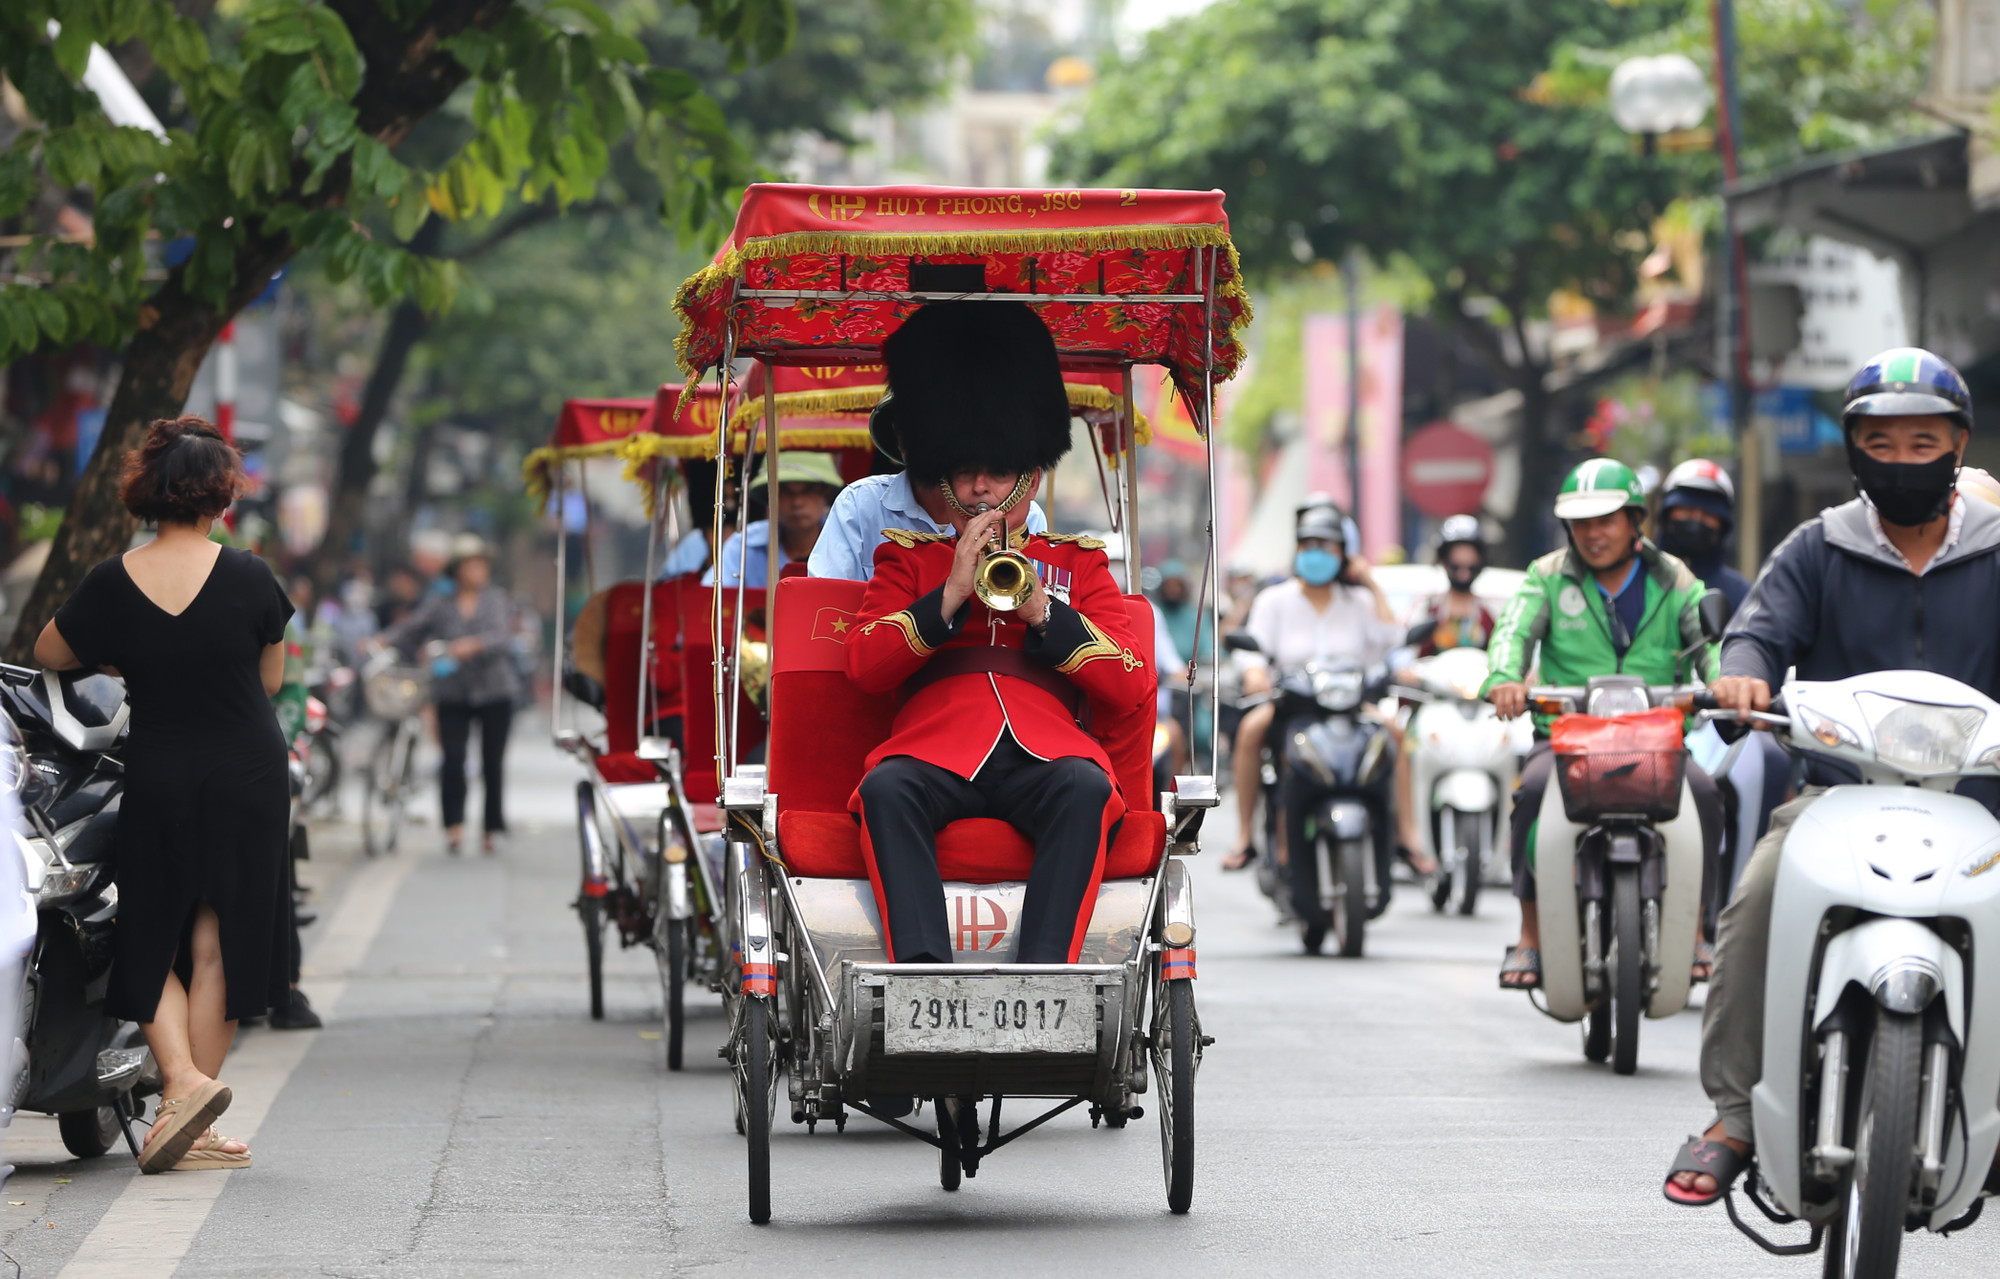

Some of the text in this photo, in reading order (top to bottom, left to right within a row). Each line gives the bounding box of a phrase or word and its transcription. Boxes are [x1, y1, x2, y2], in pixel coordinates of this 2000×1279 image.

[875, 197, 928, 216] HUY
[1039, 190, 1082, 211] JSC
[1119, 189, 1138, 207] 2
